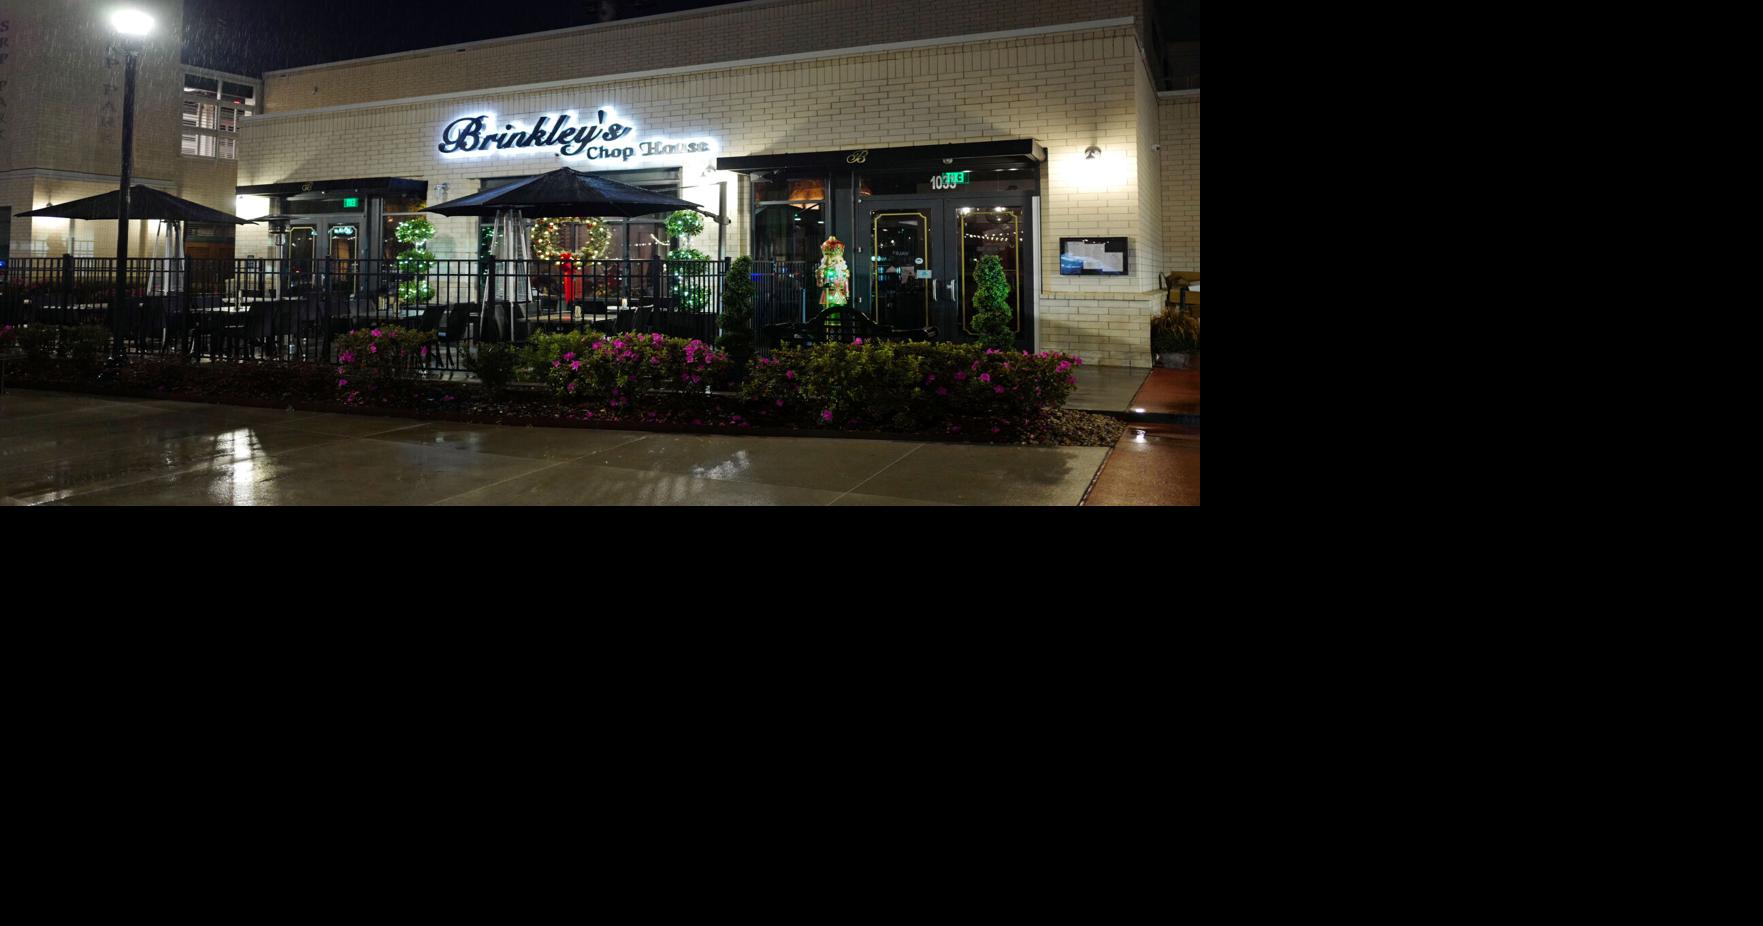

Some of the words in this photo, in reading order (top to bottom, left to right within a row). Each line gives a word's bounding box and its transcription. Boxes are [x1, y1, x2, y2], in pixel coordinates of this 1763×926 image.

[438, 110, 633, 156] Brinkley's
[586, 145, 635, 161] Chop
[639, 140, 711, 156] House
